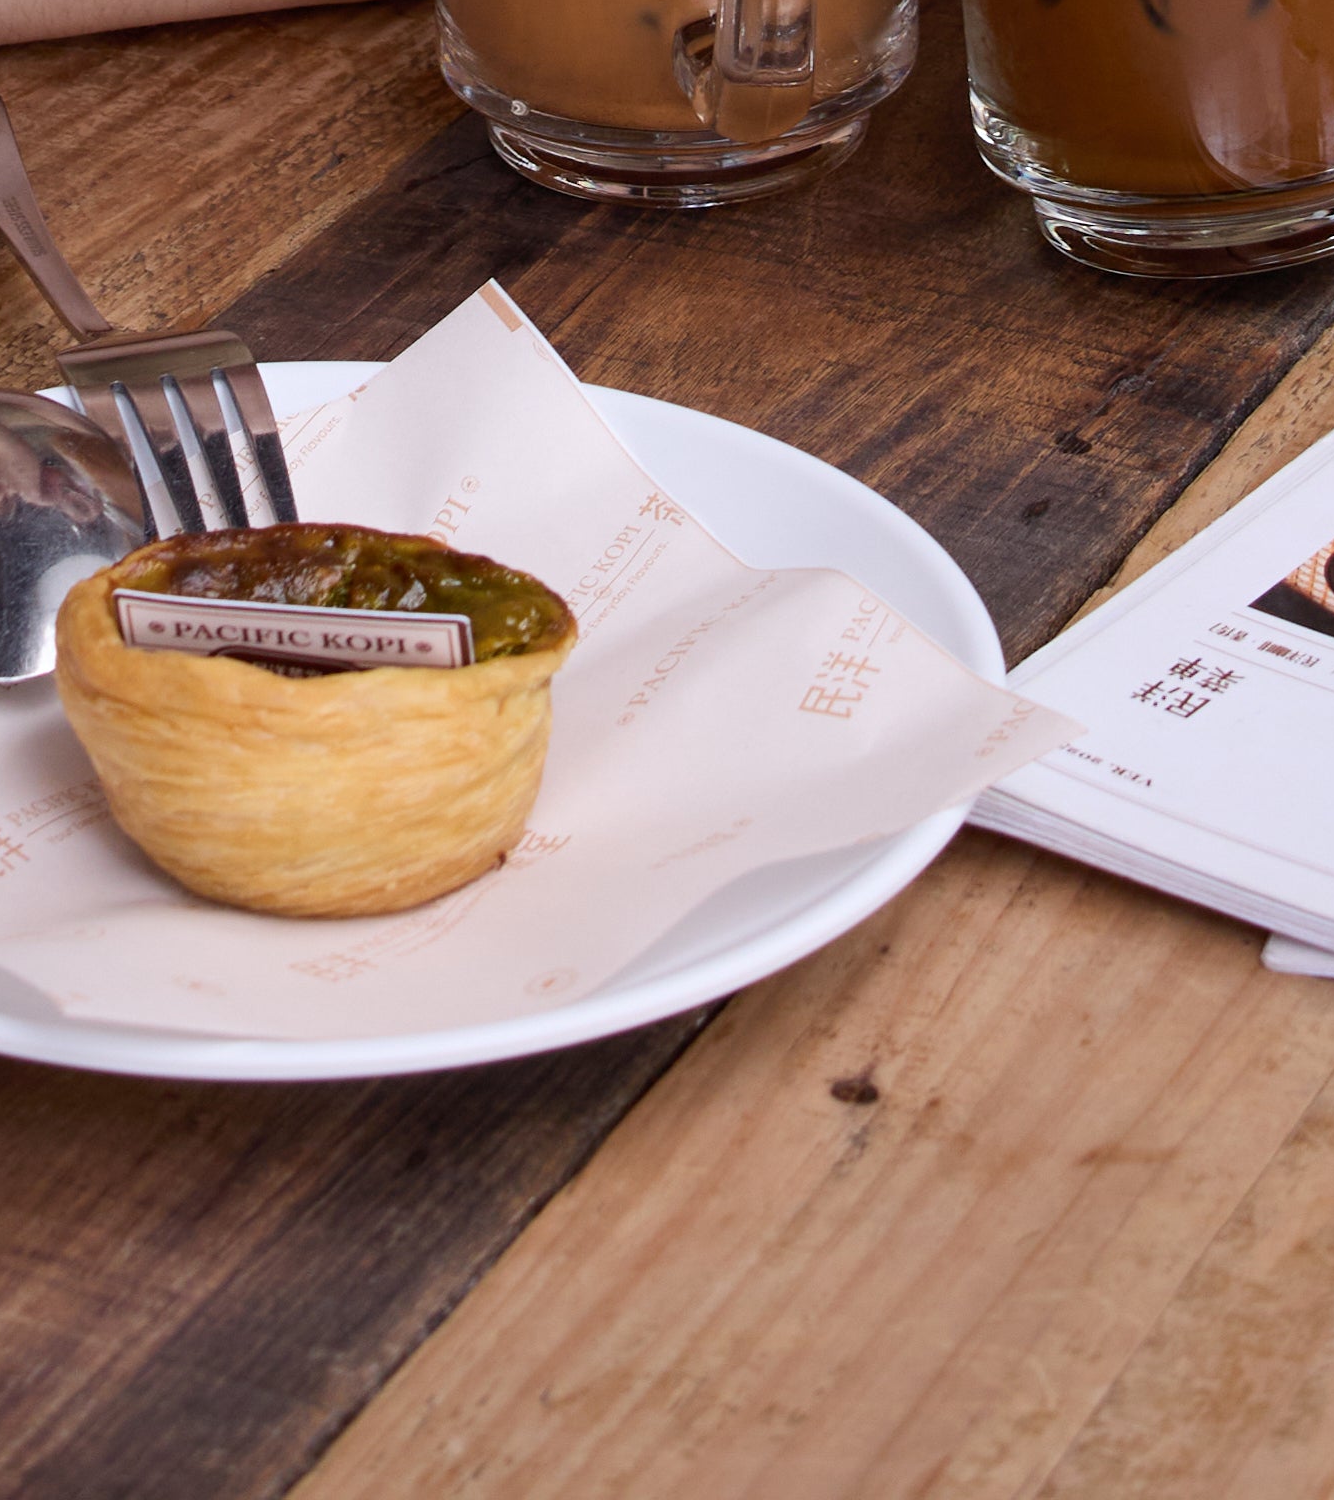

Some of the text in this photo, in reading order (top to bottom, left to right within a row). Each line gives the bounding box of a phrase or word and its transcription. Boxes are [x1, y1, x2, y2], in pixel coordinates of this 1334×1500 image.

[424, 495, 473, 545] OPI
[592, 525, 641, 574] KOPI
[173, 621, 407, 655] PACIFIC KOPI
[798, 652, 881, 719] 民洋
[1169, 658, 1243, 693] 菜单
[1132, 681, 1211, 718] 民洋
[1112, 764, 1151, 787] VER.
